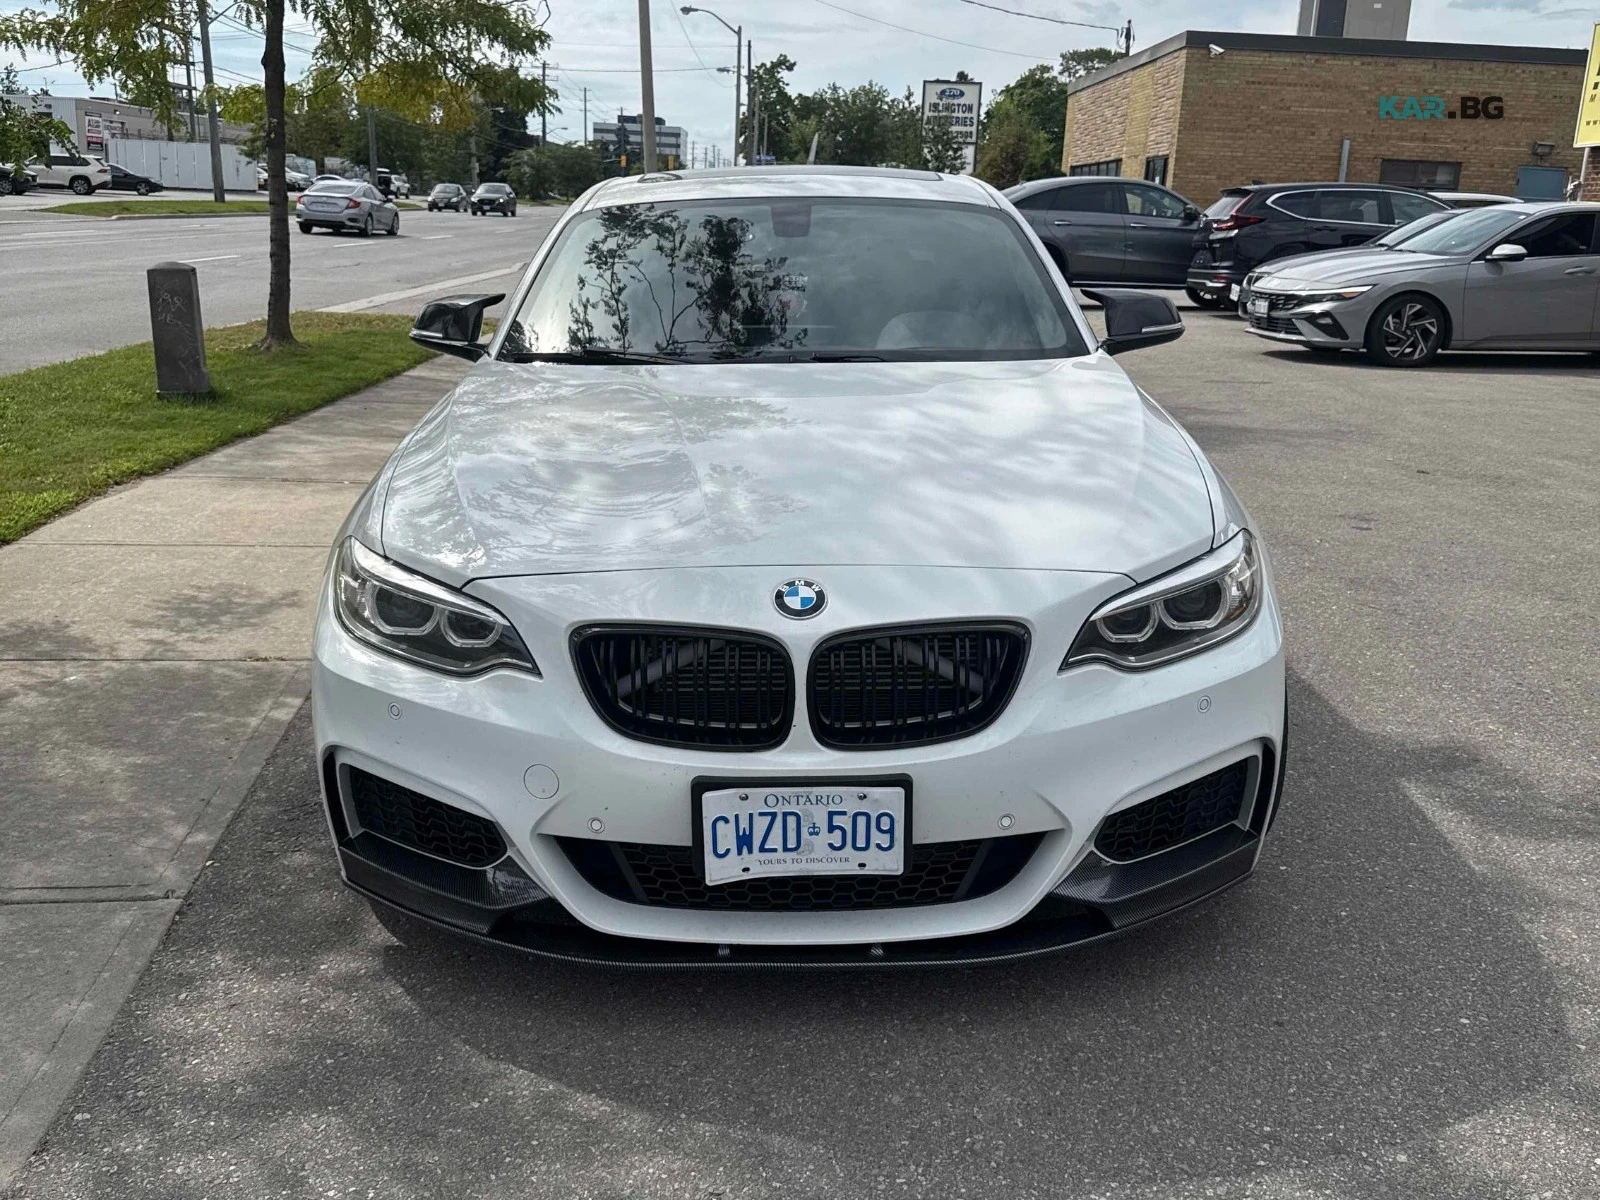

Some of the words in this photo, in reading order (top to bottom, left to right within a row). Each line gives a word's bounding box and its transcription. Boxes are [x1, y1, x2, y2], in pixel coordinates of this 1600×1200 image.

[928, 102, 974, 114] ISLINGTON
[779, 580, 822, 592] BMW
[763, 793, 843, 808] ONTARIO
[711, 810, 802, 859] CWZD
[827, 810, 895, 852] 509
[757, 857, 787, 866] YOURS
[791, 857, 802, 865] TO
[805, 856, 851, 865] DISCOVER
